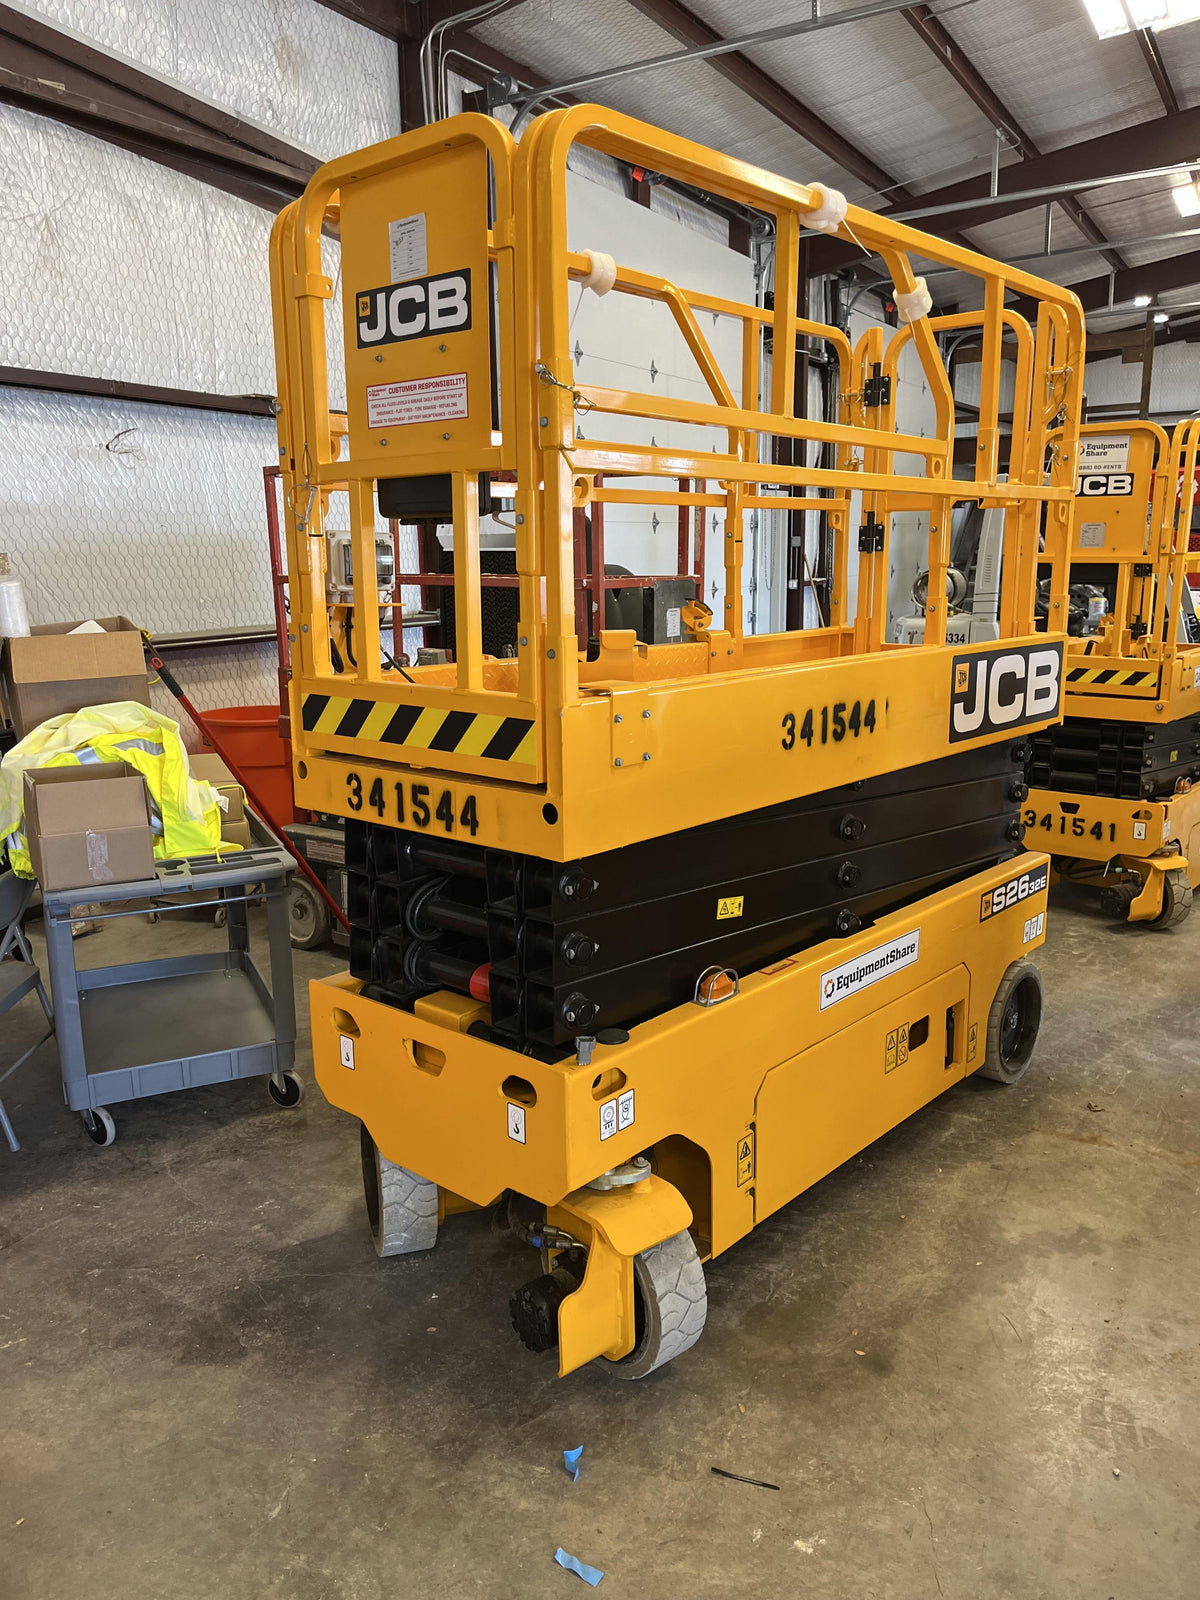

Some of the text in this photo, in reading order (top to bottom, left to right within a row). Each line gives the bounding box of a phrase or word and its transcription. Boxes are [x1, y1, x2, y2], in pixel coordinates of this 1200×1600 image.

[360, 276, 468, 342] JCB
[388, 377, 466, 395] CUSTOMER RESPONSIBILITY
[1086, 442, 1128, 451] Equipment
[954, 650, 1059, 733] JCB
[782, 699, 876, 750] 341544
[346, 773, 479, 836] 341544
[1023, 809, 1116, 842] 341541
[836, 943, 916, 990] EquipmentShare
